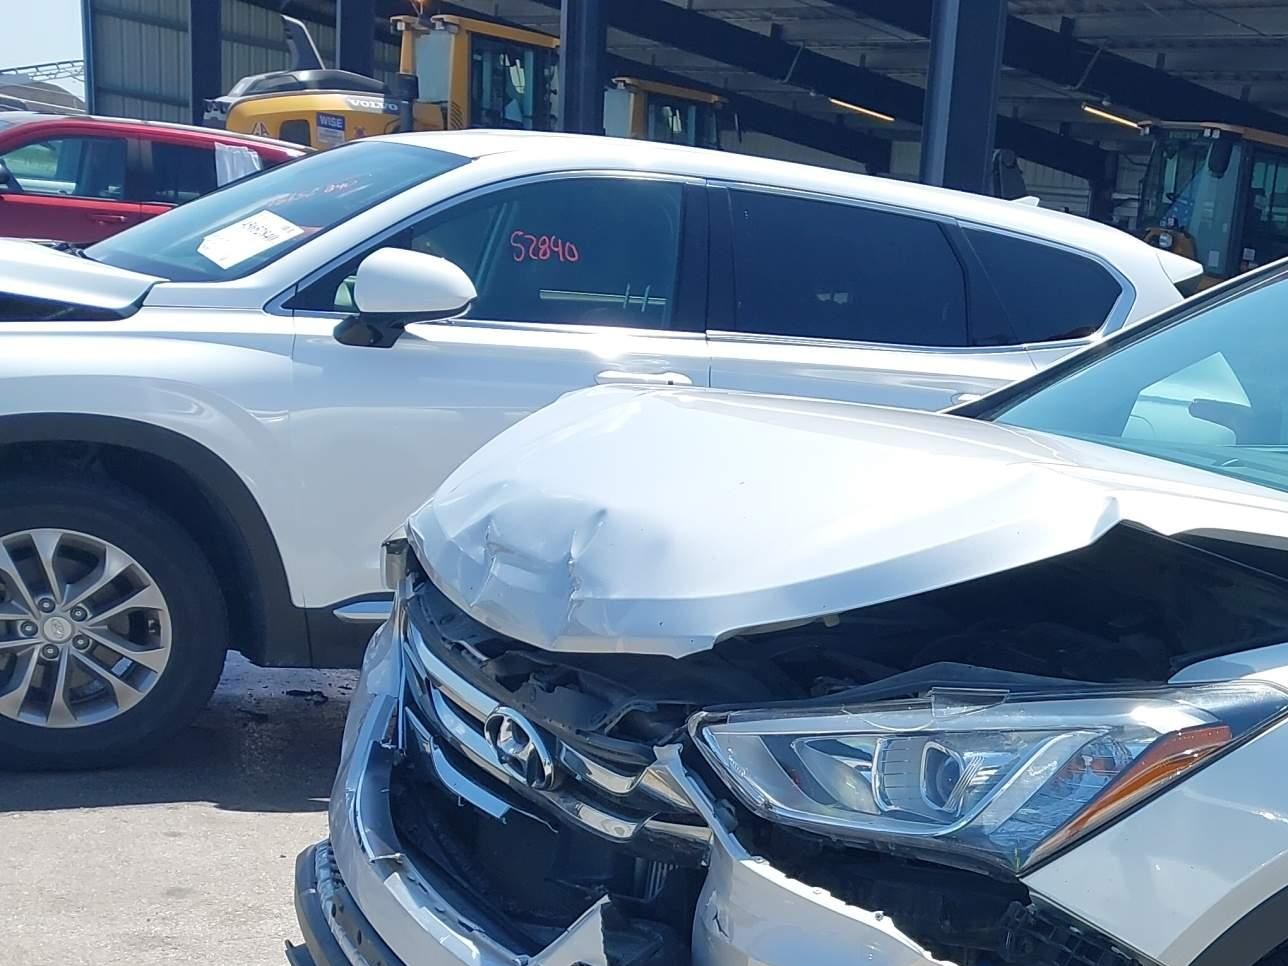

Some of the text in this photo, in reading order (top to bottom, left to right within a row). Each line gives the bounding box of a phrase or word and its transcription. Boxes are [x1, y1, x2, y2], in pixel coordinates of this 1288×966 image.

[351, 100, 398, 111] VOLVO
[319, 115, 344, 128] WISE
[510, 230, 579, 262] 52840
